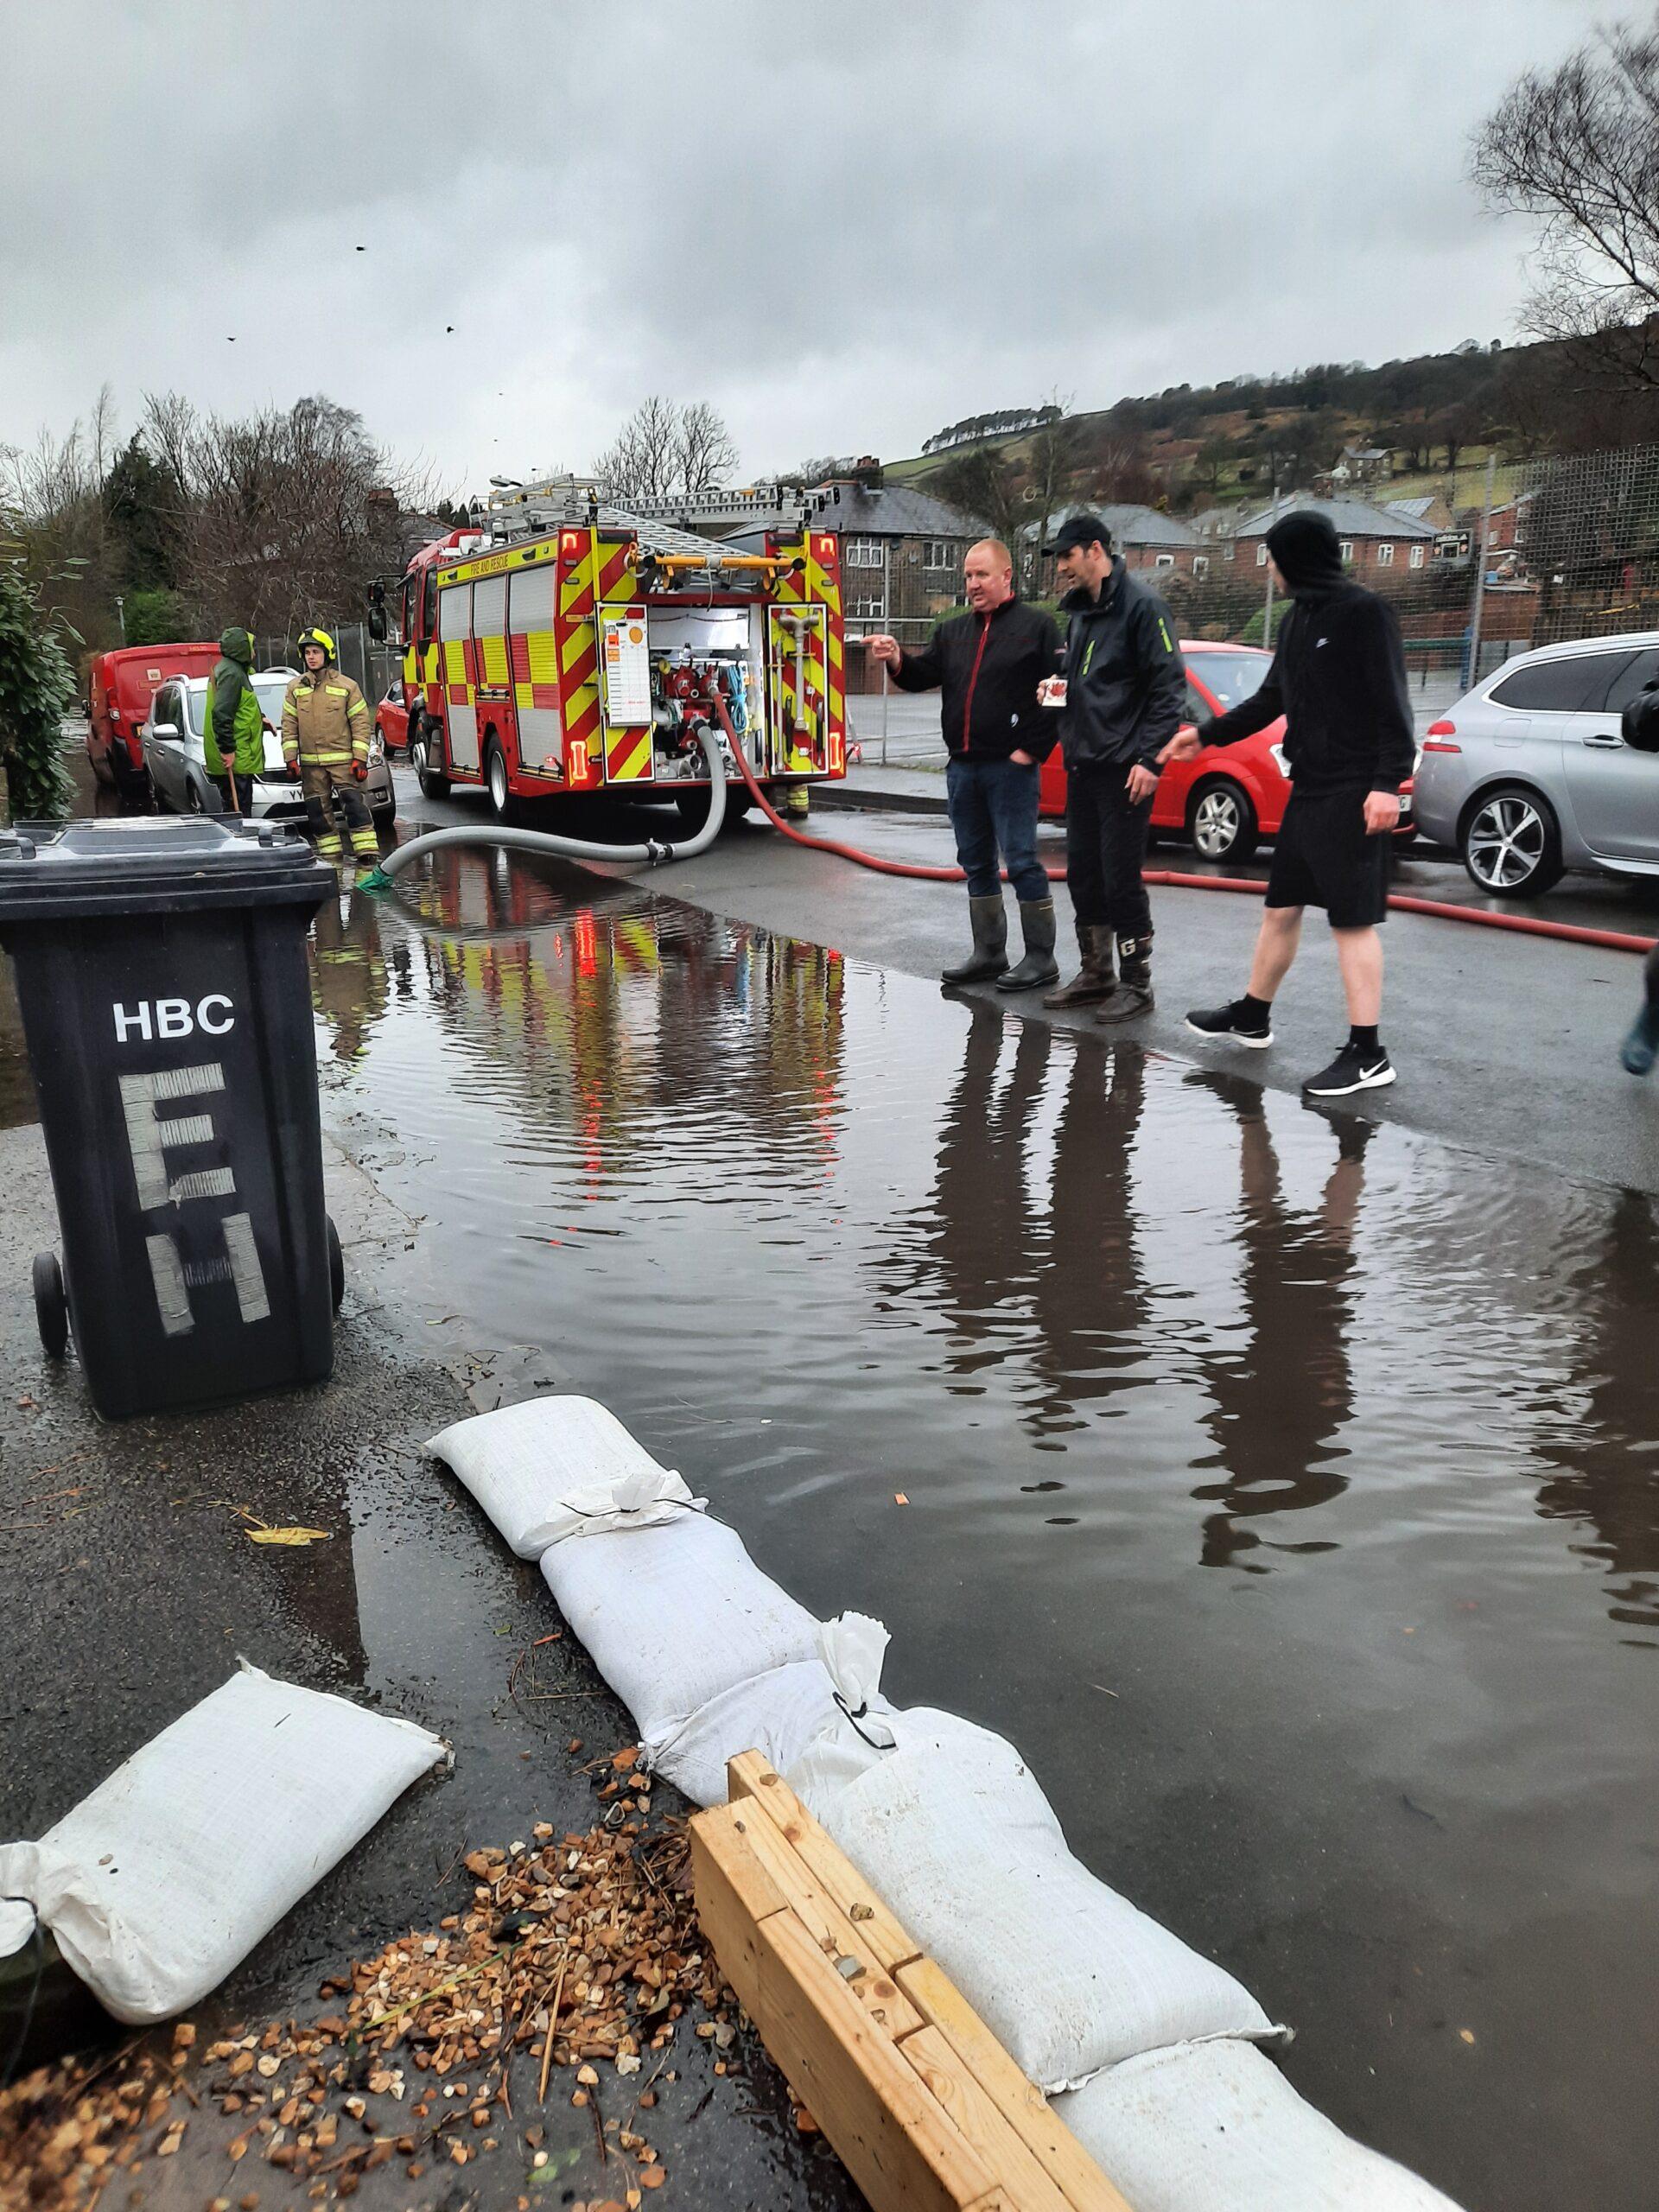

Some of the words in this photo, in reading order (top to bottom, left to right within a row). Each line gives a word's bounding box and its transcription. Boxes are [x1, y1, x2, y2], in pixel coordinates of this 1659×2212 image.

[471, 562, 480, 576] FIRE
[480, 559, 490, 573] AND
[491, 554, 509, 571] RESCUE
[112, 994, 235, 1042] HBC
